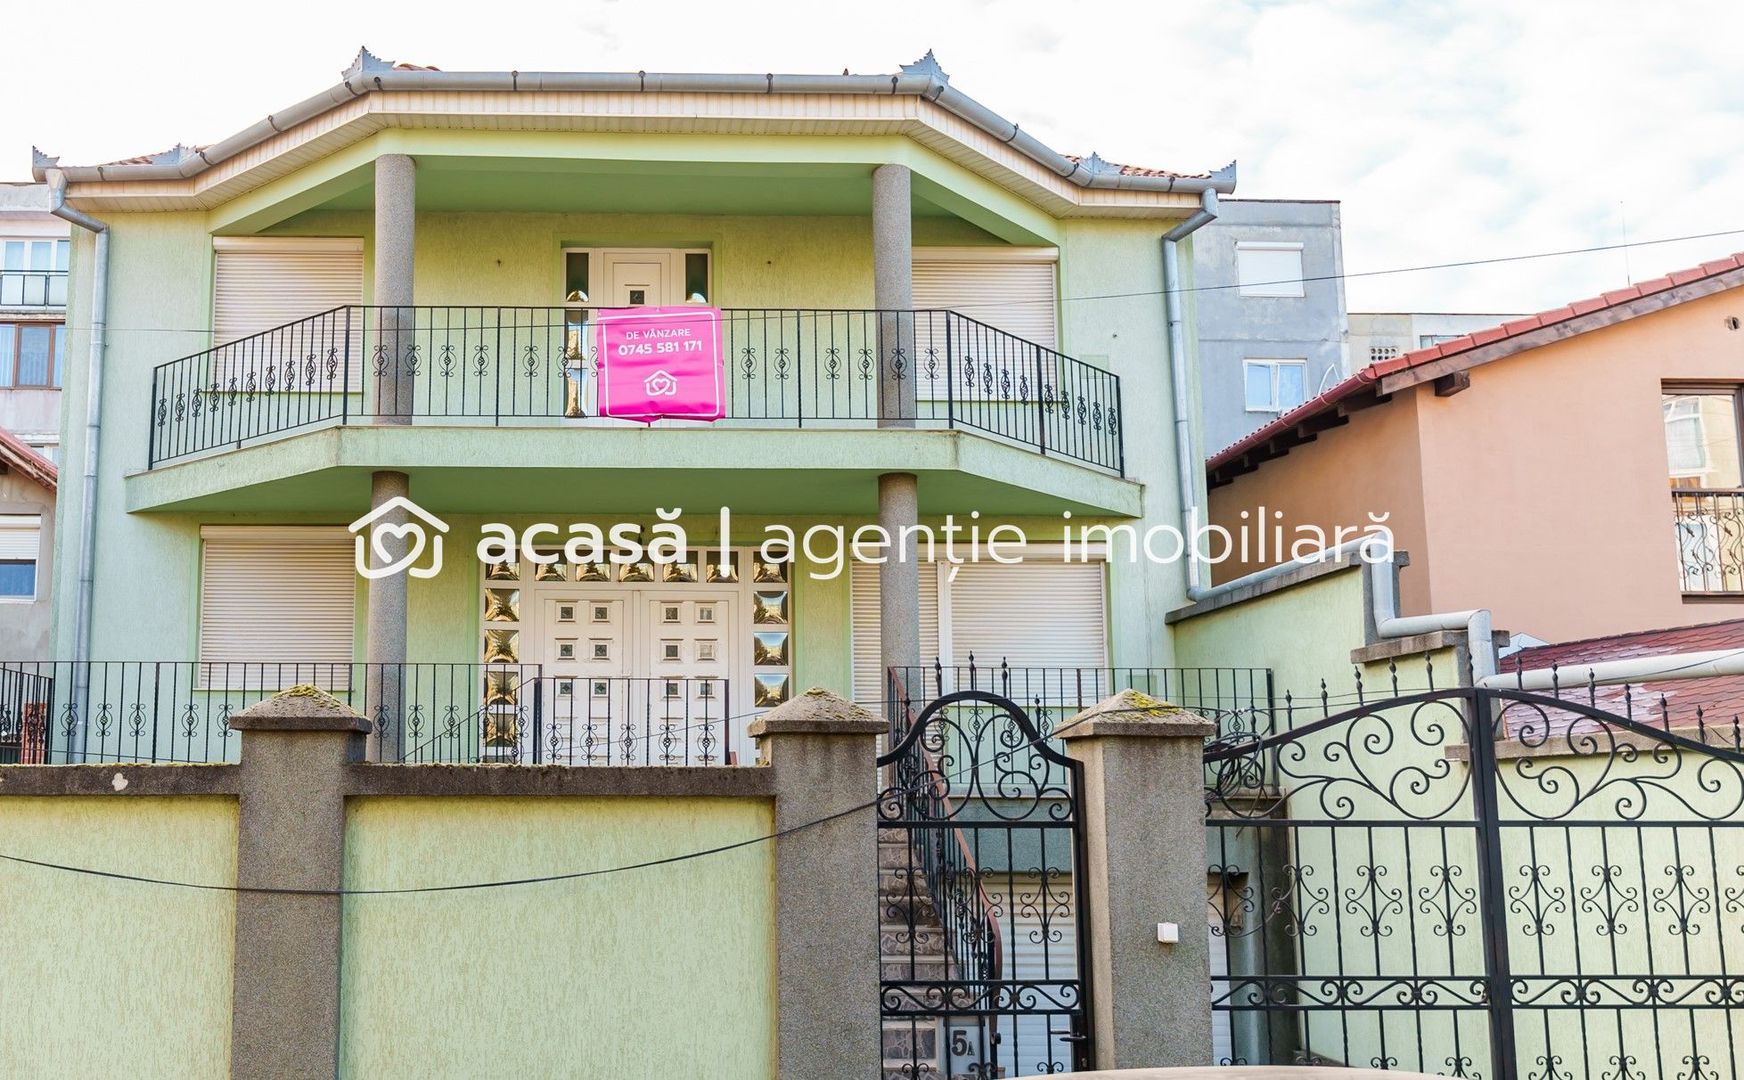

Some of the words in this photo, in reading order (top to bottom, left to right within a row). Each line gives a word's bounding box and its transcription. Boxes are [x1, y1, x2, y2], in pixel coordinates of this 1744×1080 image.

[626, 331, 640, 340] DE
[643, 328, 691, 339] VÂNZARE
[618, 344, 652, 355] 0745
[656, 342, 680, 353] 581
[683, 340, 702, 352] 171
